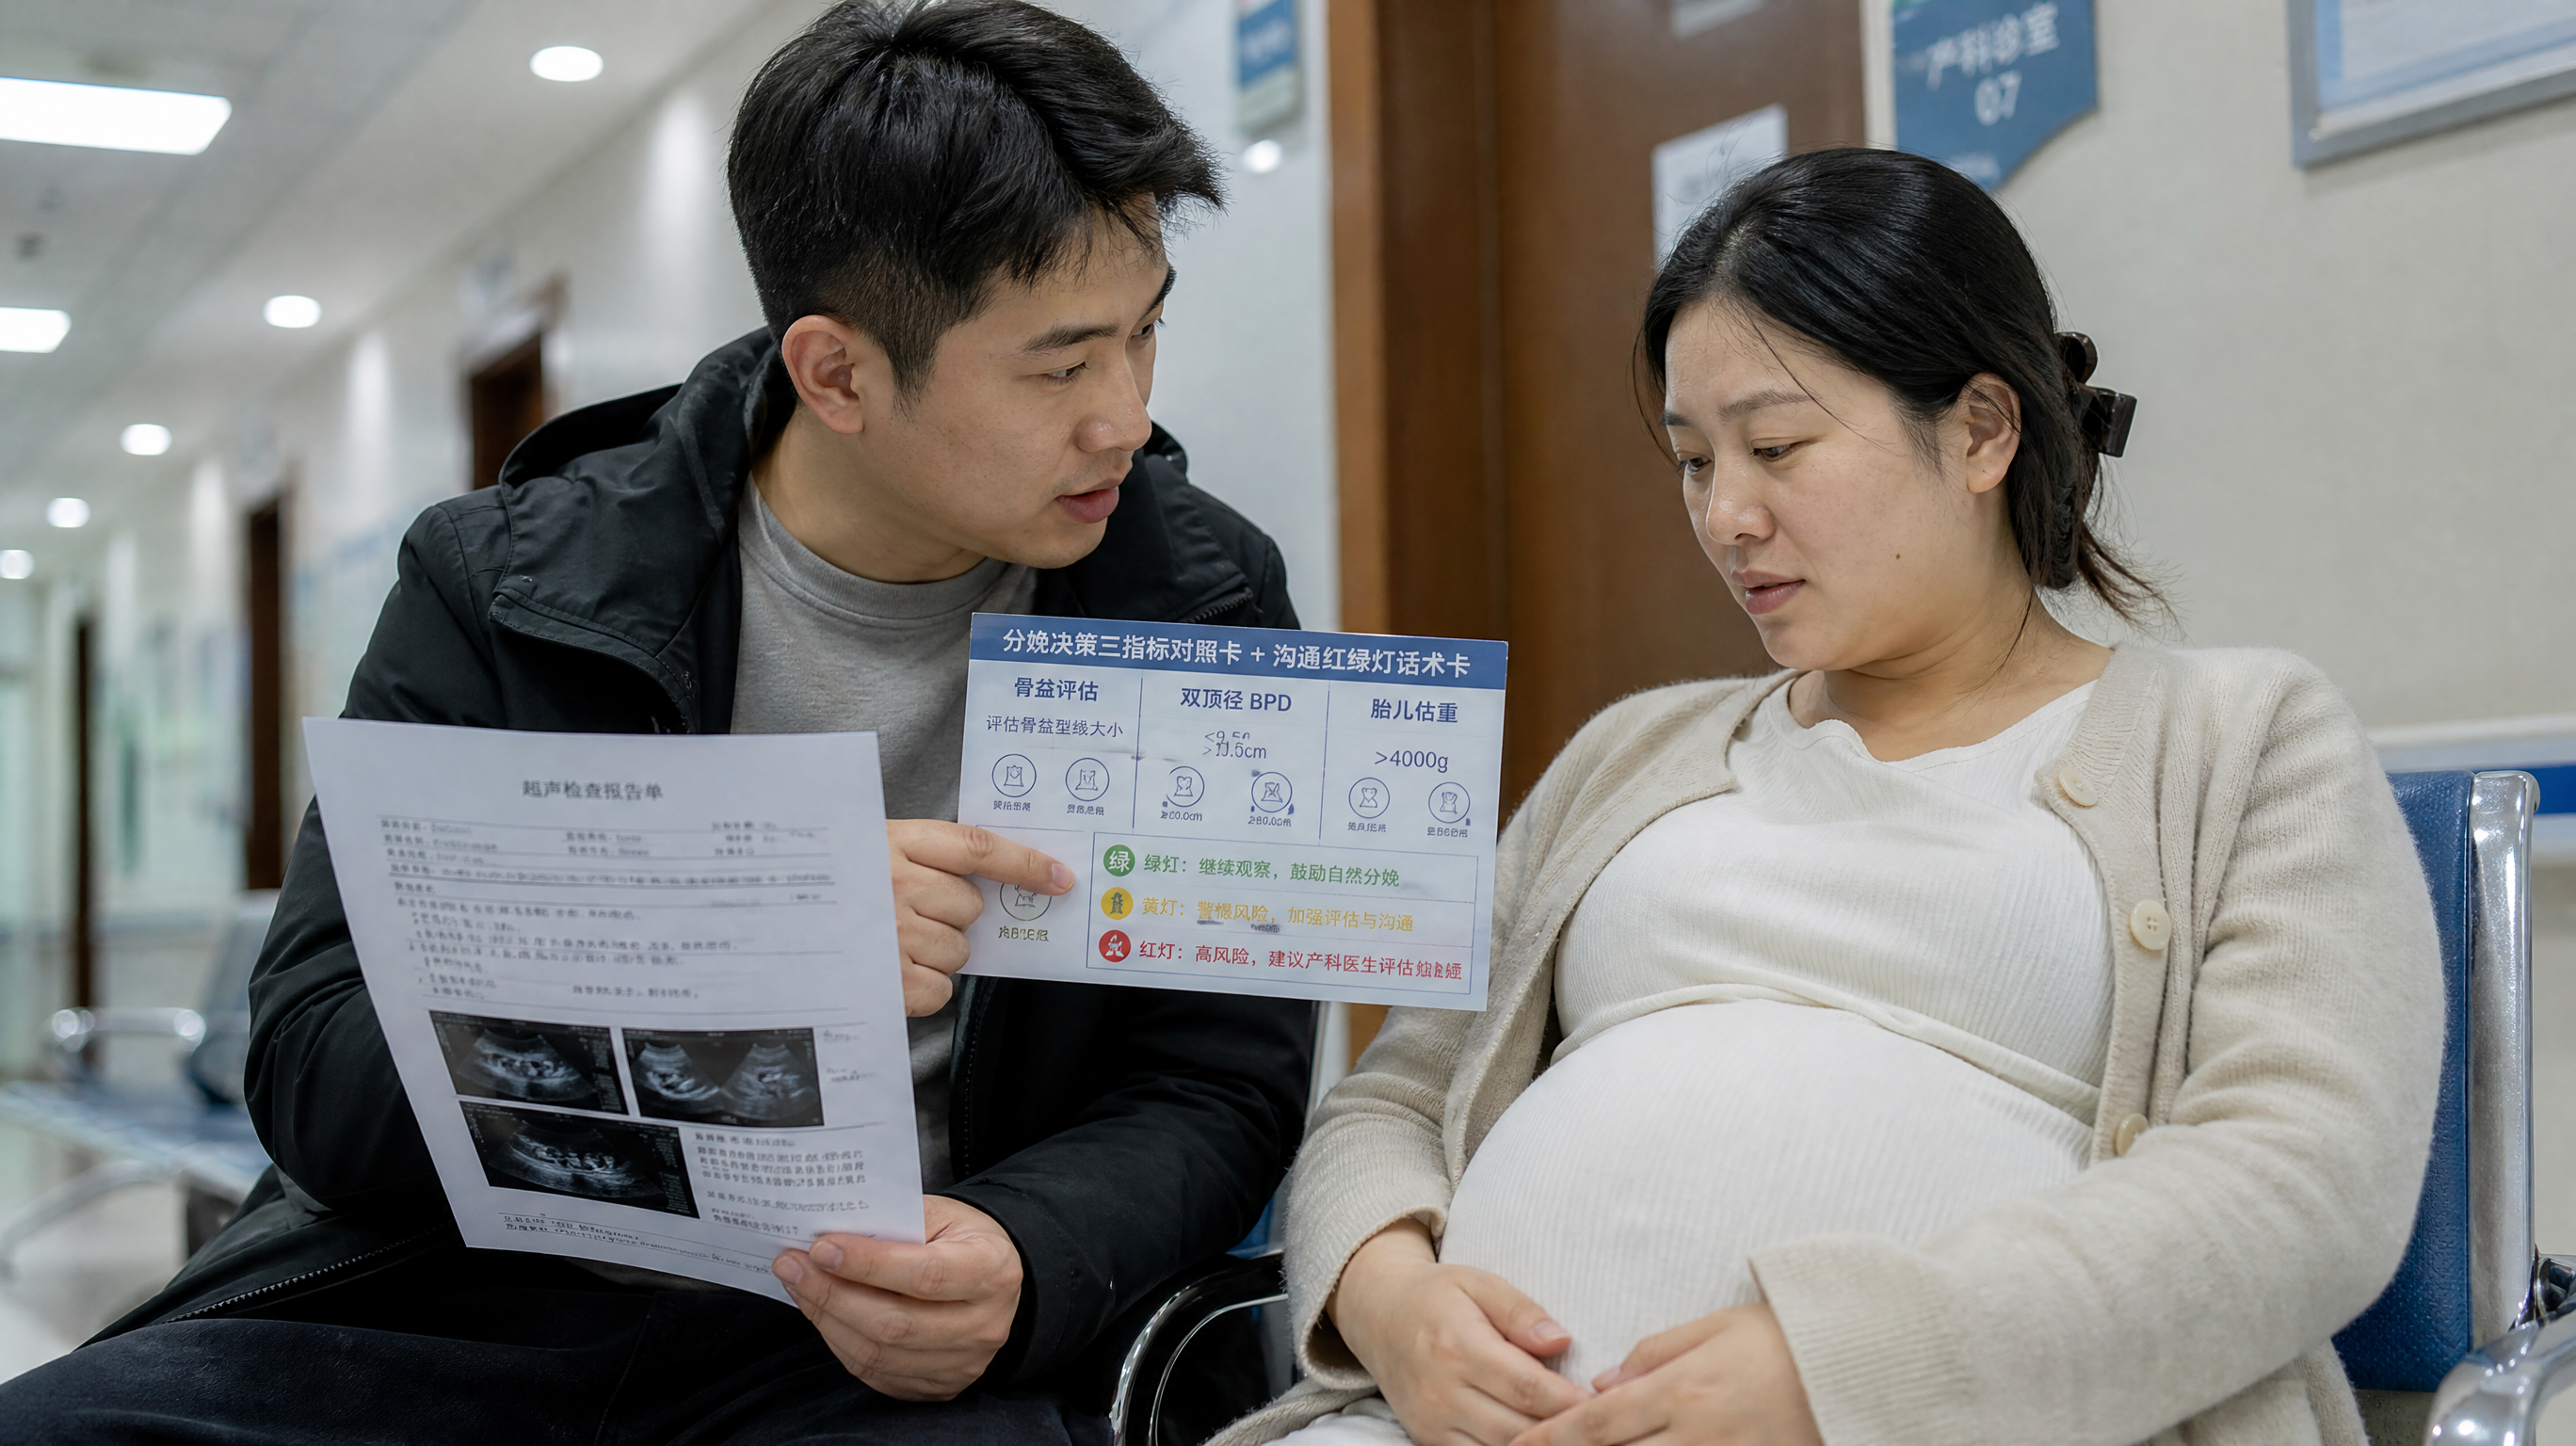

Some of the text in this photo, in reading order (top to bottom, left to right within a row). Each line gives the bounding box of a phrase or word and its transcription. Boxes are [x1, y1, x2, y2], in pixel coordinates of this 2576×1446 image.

[1974, 70, 2022, 125] 07
[1003, 628, 1471, 678] 分娩决策三指标对照卡 + 沟通红绿灯话术卡
[1180, 687, 1292, 712] 双顶径 BPD
[1371, 699, 1458, 723] 胎儿估重
[1375, 750, 1449, 773] >4000g
[1108, 850, 1131, 873] 绿
